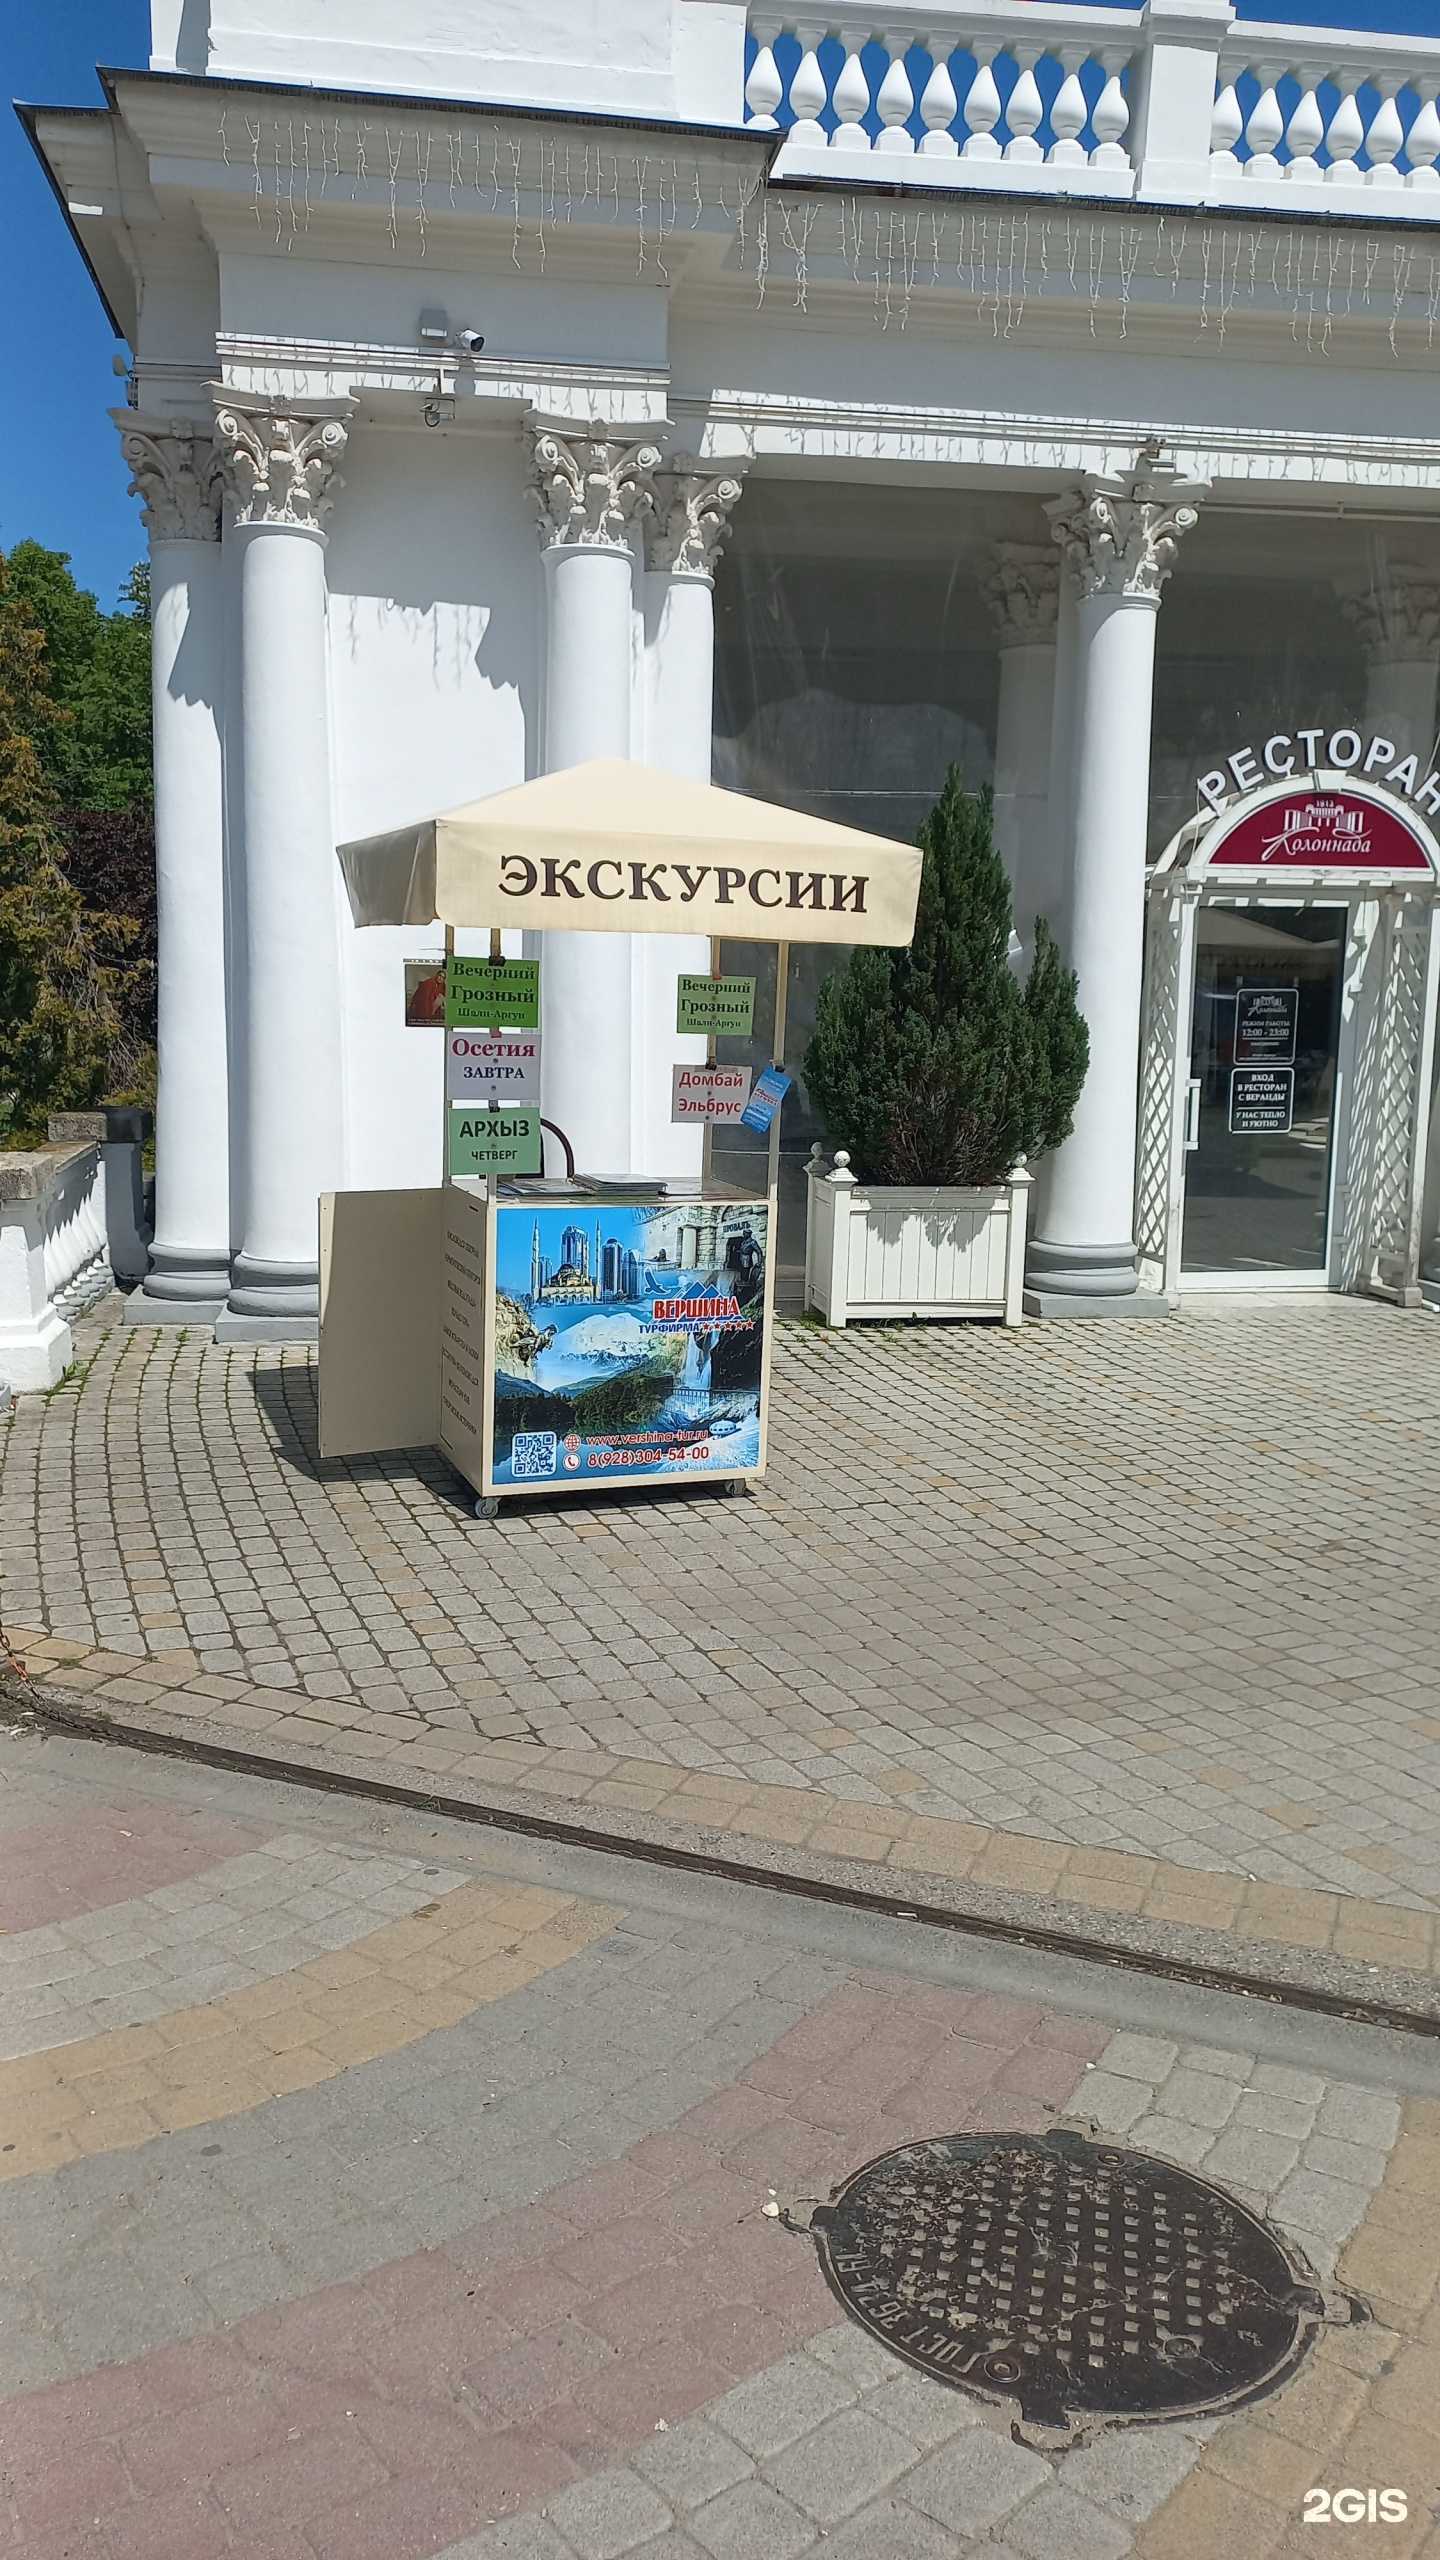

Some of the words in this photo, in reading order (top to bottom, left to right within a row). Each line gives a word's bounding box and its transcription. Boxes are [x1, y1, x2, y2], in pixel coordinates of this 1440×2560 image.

[1198, 728, 1440, 819] РЕСТОРАН
[1261, 826, 1373, 862] Колоннада
[498, 855, 870, 914] ЭКСКУРСИИ
[453, 962, 535, 981] Вечерний
[450, 985, 535, 1004] Грозный
[682, 979, 751, 994] Вечерний
[681, 999, 750, 1014] Грозный
[452, 1038, 536, 1058] Осетия
[463, 1066, 525, 1080] ЗАВТРА
[678, 1071, 743, 1089] Домбай
[1251, 1073, 1275, 1083] ВХОД
[1244, 1083, 1288, 1092] РЕСТОРАН
[1245, 1093, 1286, 1102] ВЕРАНДЫ
[678, 1098, 742, 1116] Эльбрус
[1259, 1110, 1286, 1119] ТЕПЛО
[459, 1120, 530, 1138] АРХЫЗ
[471, 1150, 518, 1161] ЧЕТВЕРГ
[653, 1296, 741, 1321] ВЕРШИНА
[639, 1323, 701, 1334] ТУРФИРМА
[586, 1429, 709, 1447] www.vershina-tur.ru
[588, 1446, 709, 1468] 8(928)304-54-00
